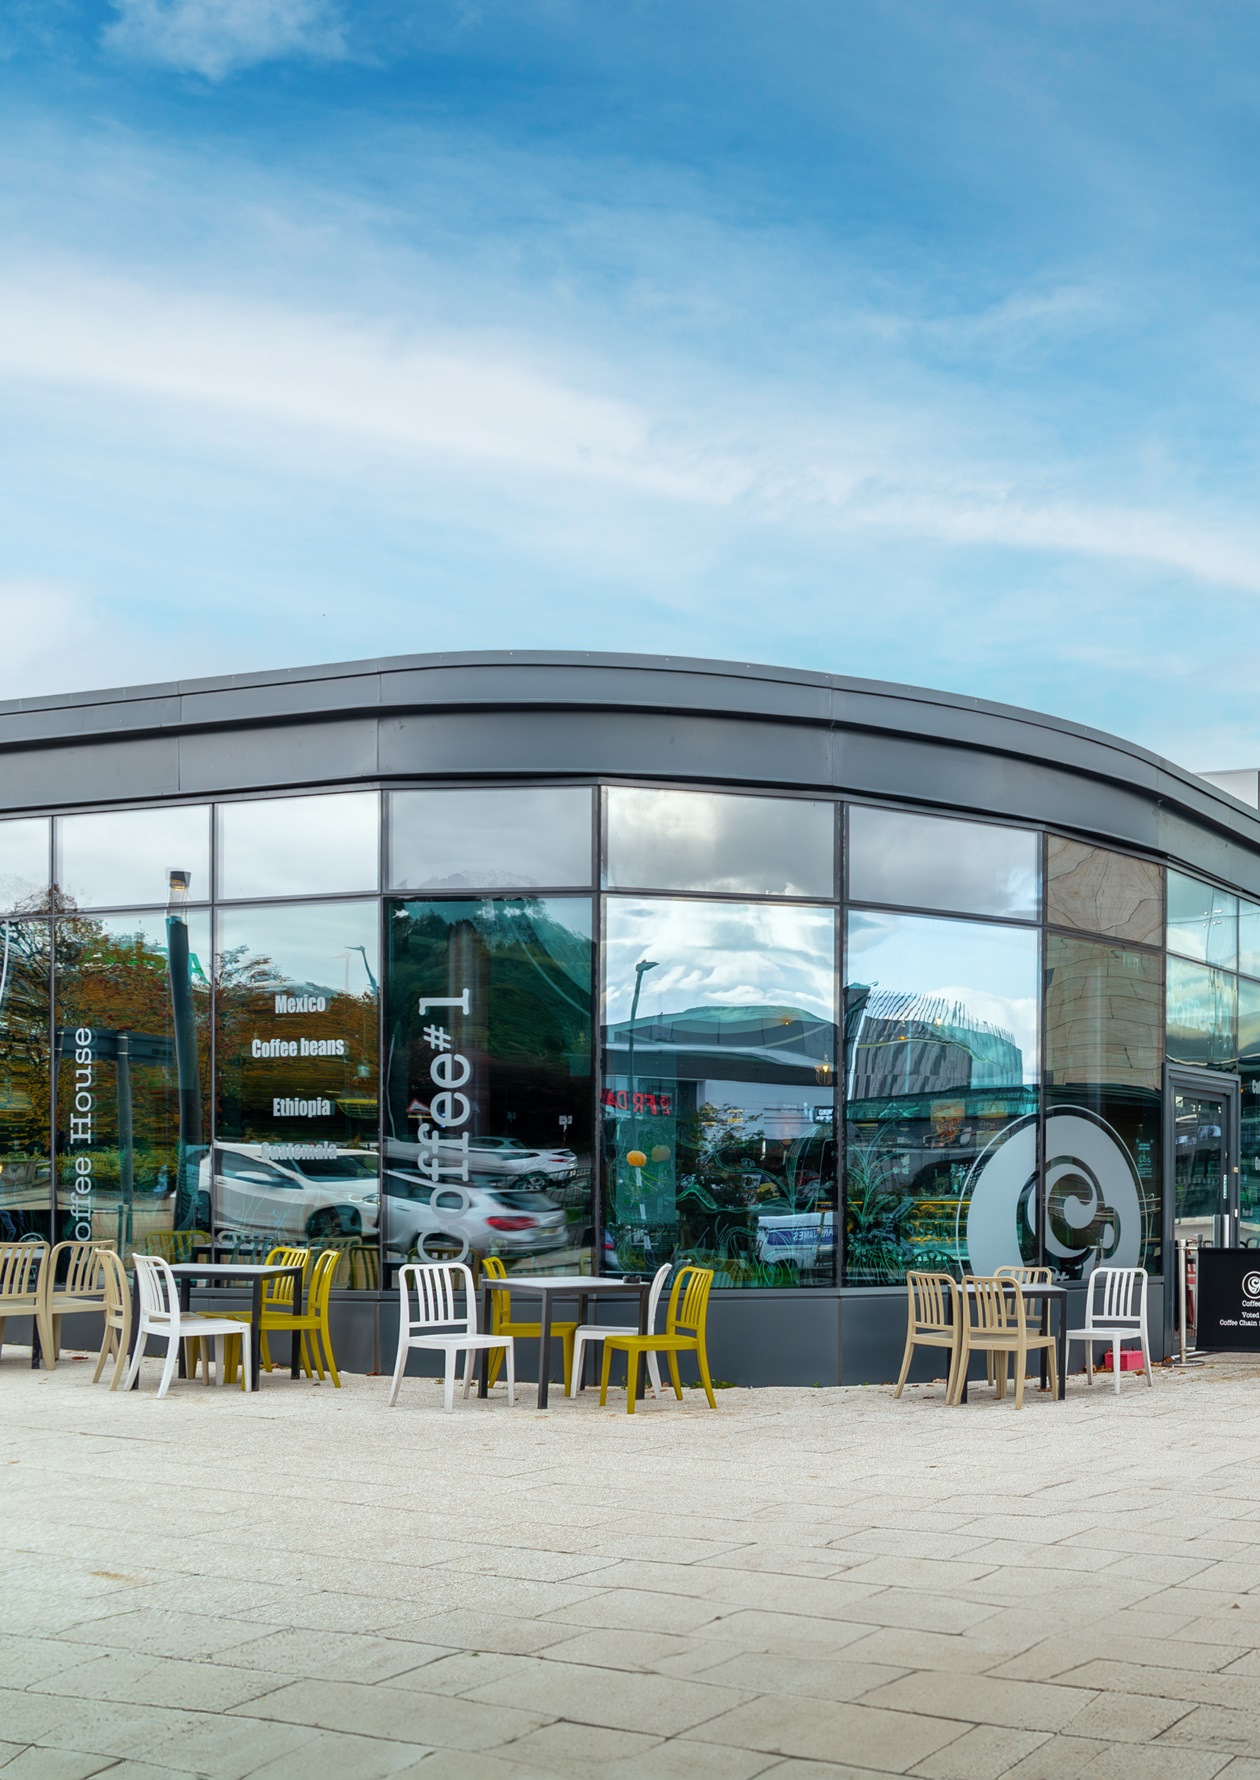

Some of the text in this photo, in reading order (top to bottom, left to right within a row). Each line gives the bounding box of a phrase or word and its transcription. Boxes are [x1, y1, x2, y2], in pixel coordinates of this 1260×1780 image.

[274, 994, 326, 1014] Mexico
[251, 1038, 345, 1058] Coffee beans
[272, 1097, 331, 1118] Ethiopia
[70, 1027, 92, 1243] offee House
[260, 1141, 338, 1160] Guatemala
[1241, 1311, 1259, 1319] Voted
